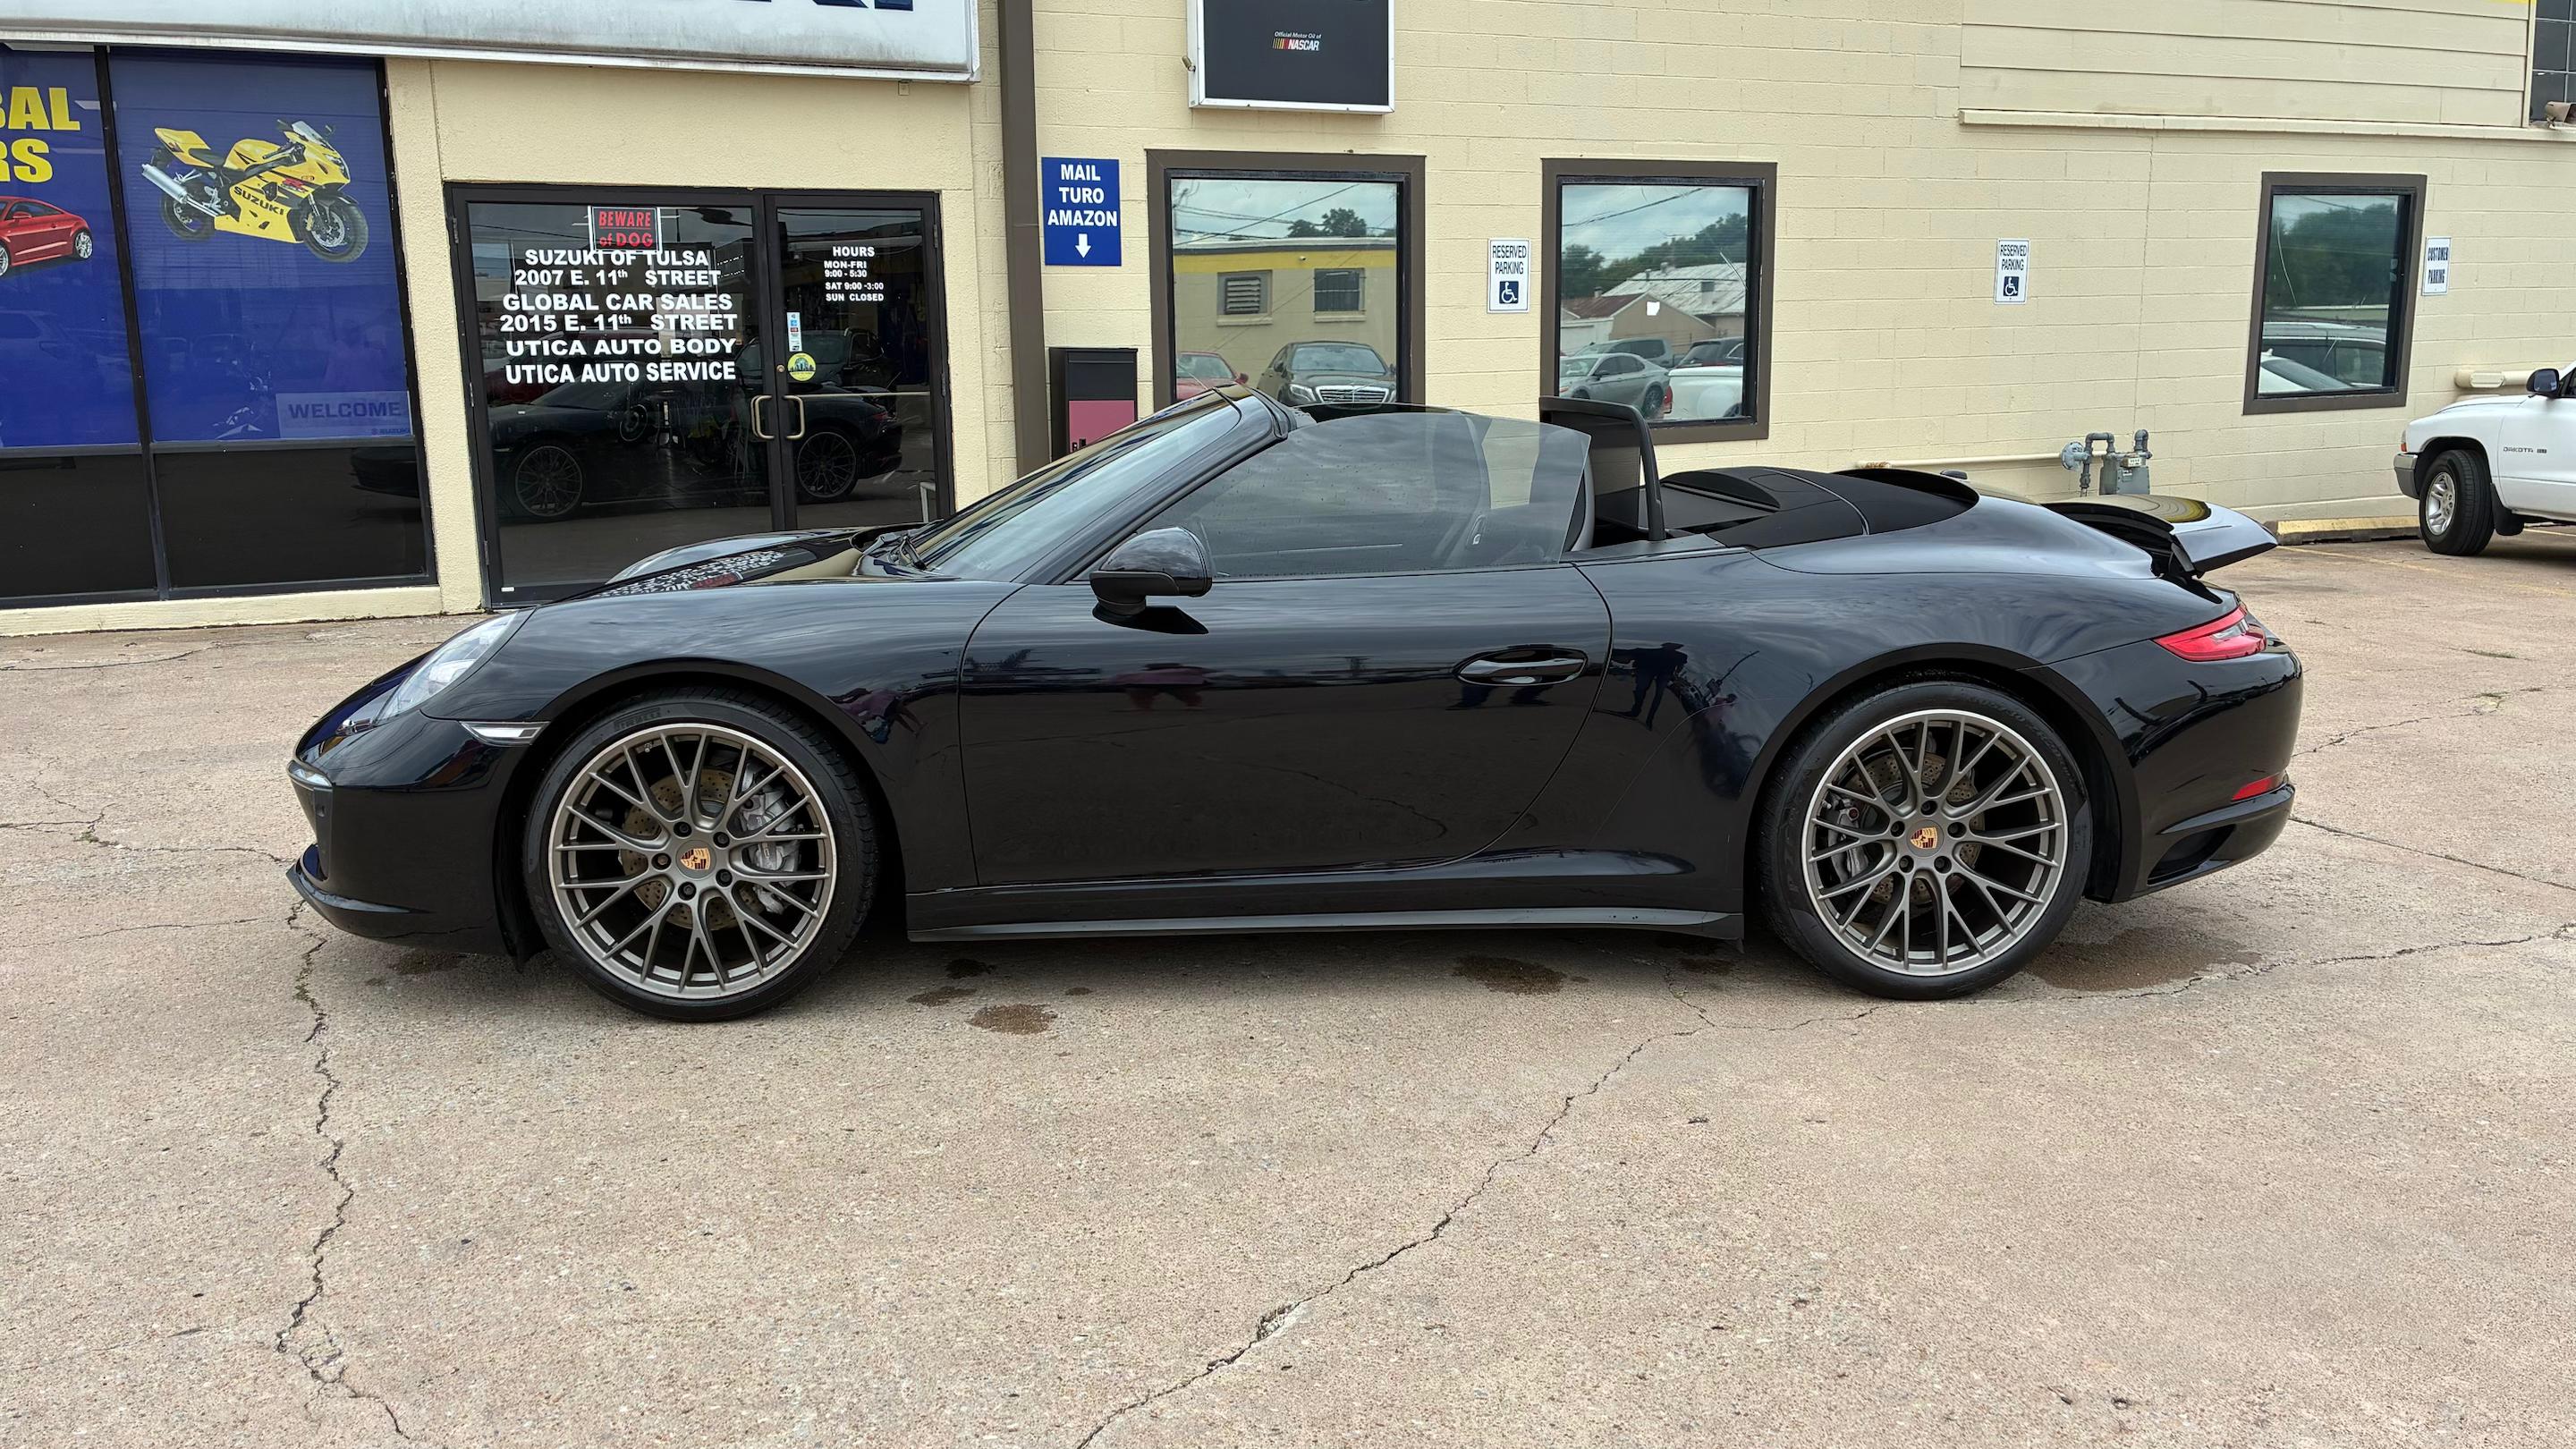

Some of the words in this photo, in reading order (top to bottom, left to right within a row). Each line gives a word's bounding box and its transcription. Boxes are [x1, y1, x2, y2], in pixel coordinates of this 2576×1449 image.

[1288, 39, 1320, 51] NASCAR
[0, 86, 80, 131] AL
[0, 138, 53, 183] S
[1060, 164, 1101, 181] MAIL
[234, 186, 284, 215] SUZUKI
[1059, 186, 1105, 204] TURO
[599, 211, 651, 227] BEWARE
[1047, 209, 1117, 227] AMAZON
[599, 233, 612, 247] of
[616, 232, 653, 247] DOG
[525, 250, 604, 266] SUZUKI
[611, 250, 637, 266] OF
[646, 250, 709, 266] TULSA
[832, 246, 875, 257] HOURS
[1492, 245, 1527, 258] RESERVED
[2000, 244, 2027, 257] RESERVED
[2428, 247, 2449, 261] CUSTOMER
[823, 260, 867, 269] MON-FRI
[1495, 261, 1524, 275] PARKING
[2002, 258, 2024, 271] PARKING
[515, 270, 562, 285] 2007
[571, 270, 589, 285] E.
[596, 270, 628, 285] 11th
[645, 270, 721, 285] STREET
[824, 269, 843, 278] 9:00
[849, 269, 867, 278] 5:30
[2428, 269, 2445, 284] PARKING
[825, 282, 843, 290] SAT
[844, 282, 862, 290] 9:00
[503, 293, 599, 311] GLOBAL
[606, 293, 654, 311] CAR
[661, 293, 733, 310] SALES
[826, 293, 845, 301] SUN
[849, 293, 884, 301] CLOSED
[500, 314, 557, 332] 2015
[564, 314, 586, 331] E.
[593, 314, 632, 331] 11th
[651, 314, 737, 330] STREET
[506, 339, 587, 356] UTICA
[594, 339, 662, 355] AUTO
[671, 338, 737, 354] BODY
[505, 364, 575, 385] UTICA
[581, 363, 640, 383] AUTO
[646, 361, 736, 381] SERVICE
[288, 402, 401, 419] WELCOME
